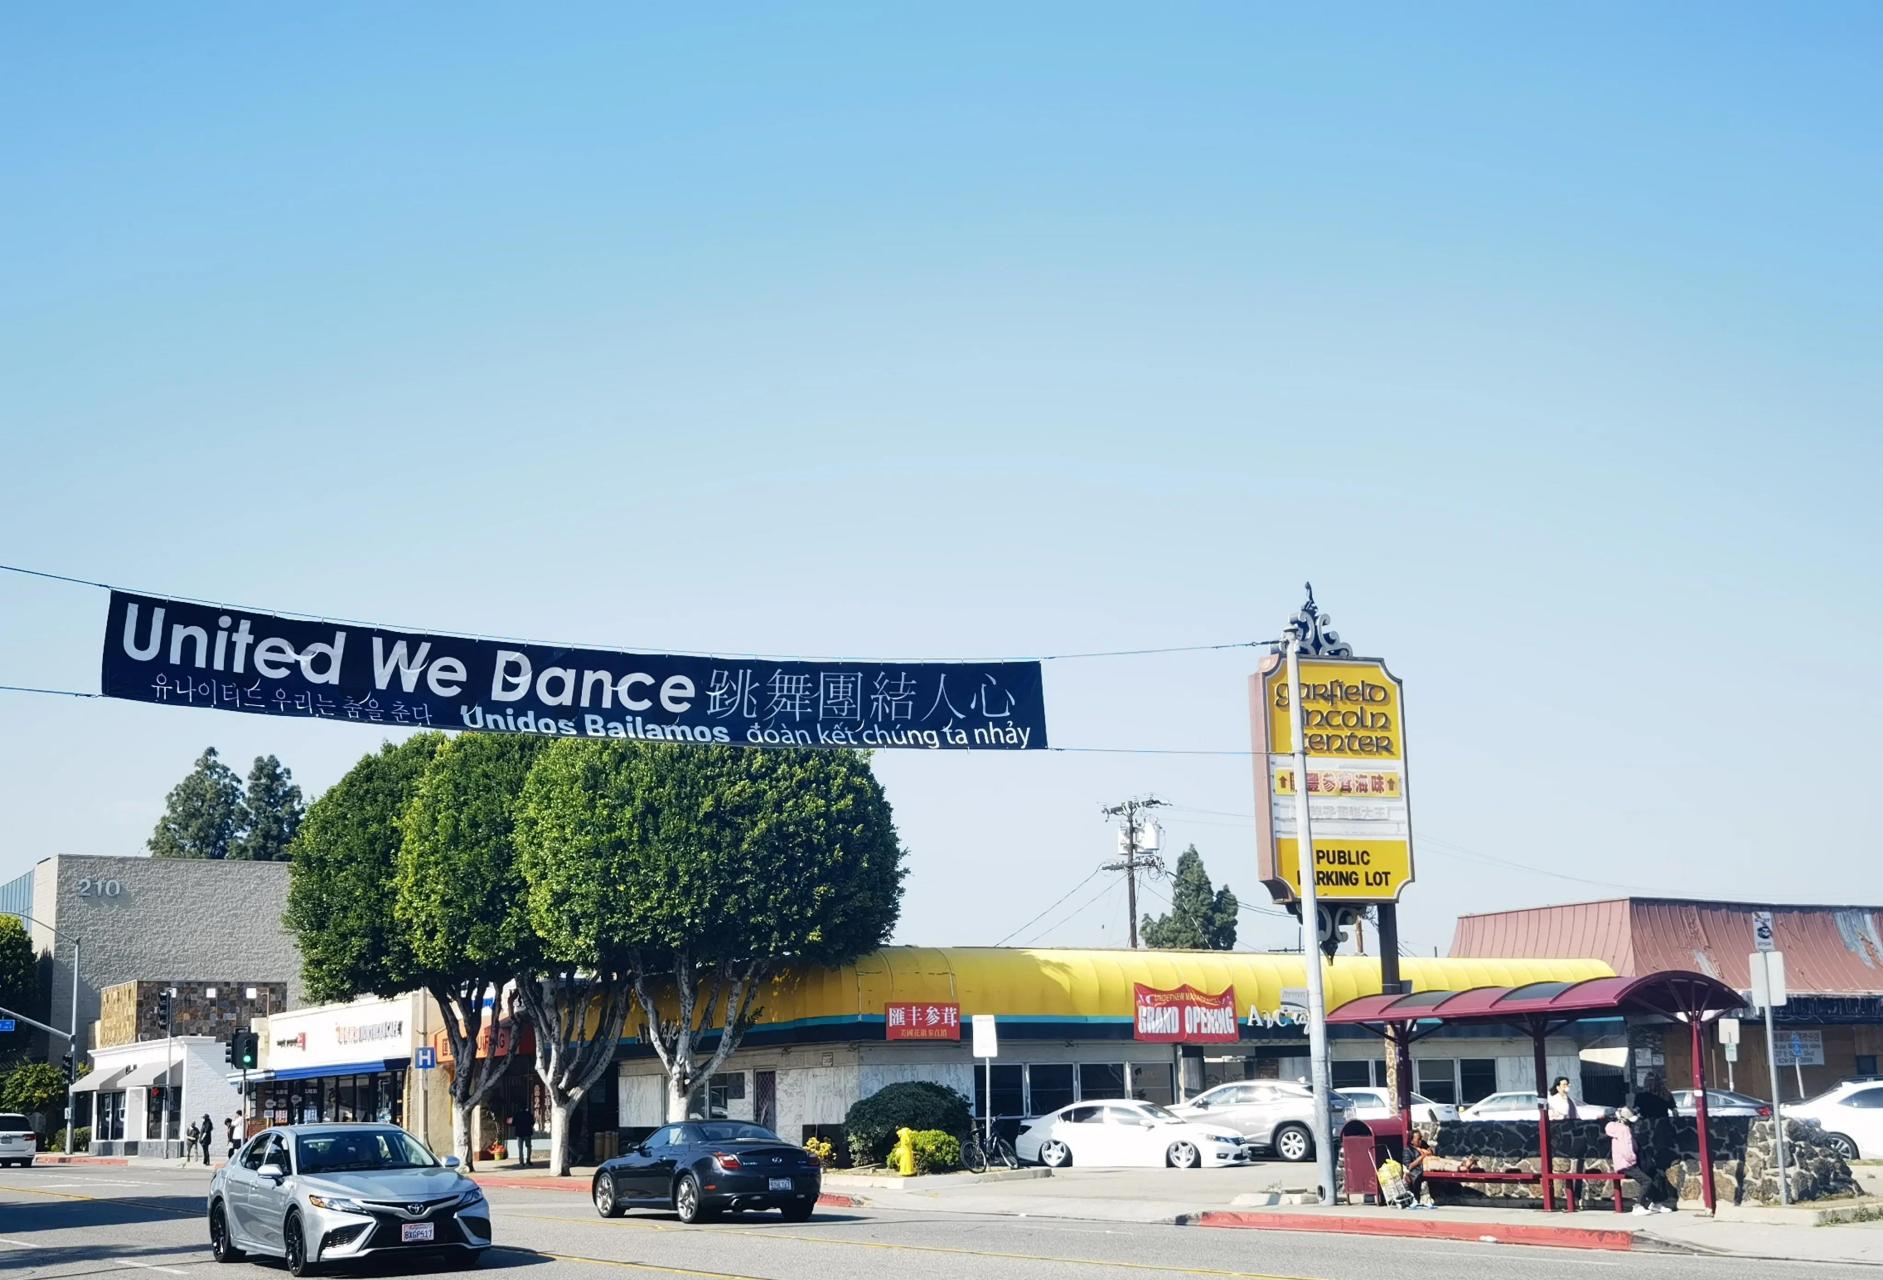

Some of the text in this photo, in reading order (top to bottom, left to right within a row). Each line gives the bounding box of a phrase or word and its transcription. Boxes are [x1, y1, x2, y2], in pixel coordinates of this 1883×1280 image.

[123, 602, 696, 713] United We Dance
[151, 673, 265, 708] 유나이티드
[272, 688, 336, 715] 우리는
[390, 700, 433, 726] 춘다
[705, 668, 1016, 722] 跳舞團結人心
[460, 704, 730, 743] Unidos Bailamos
[746, 720, 1031, 749] đoàn kết chúng ta nhảy
[1316, 850, 1370, 865] PUBLIC
[78, 879, 120, 897] 210
[1365, 871, 1391, 886] LOT
[1138, 1006, 1235, 1034] GRAND OPENING
[418, 1049, 431, 1066] H
